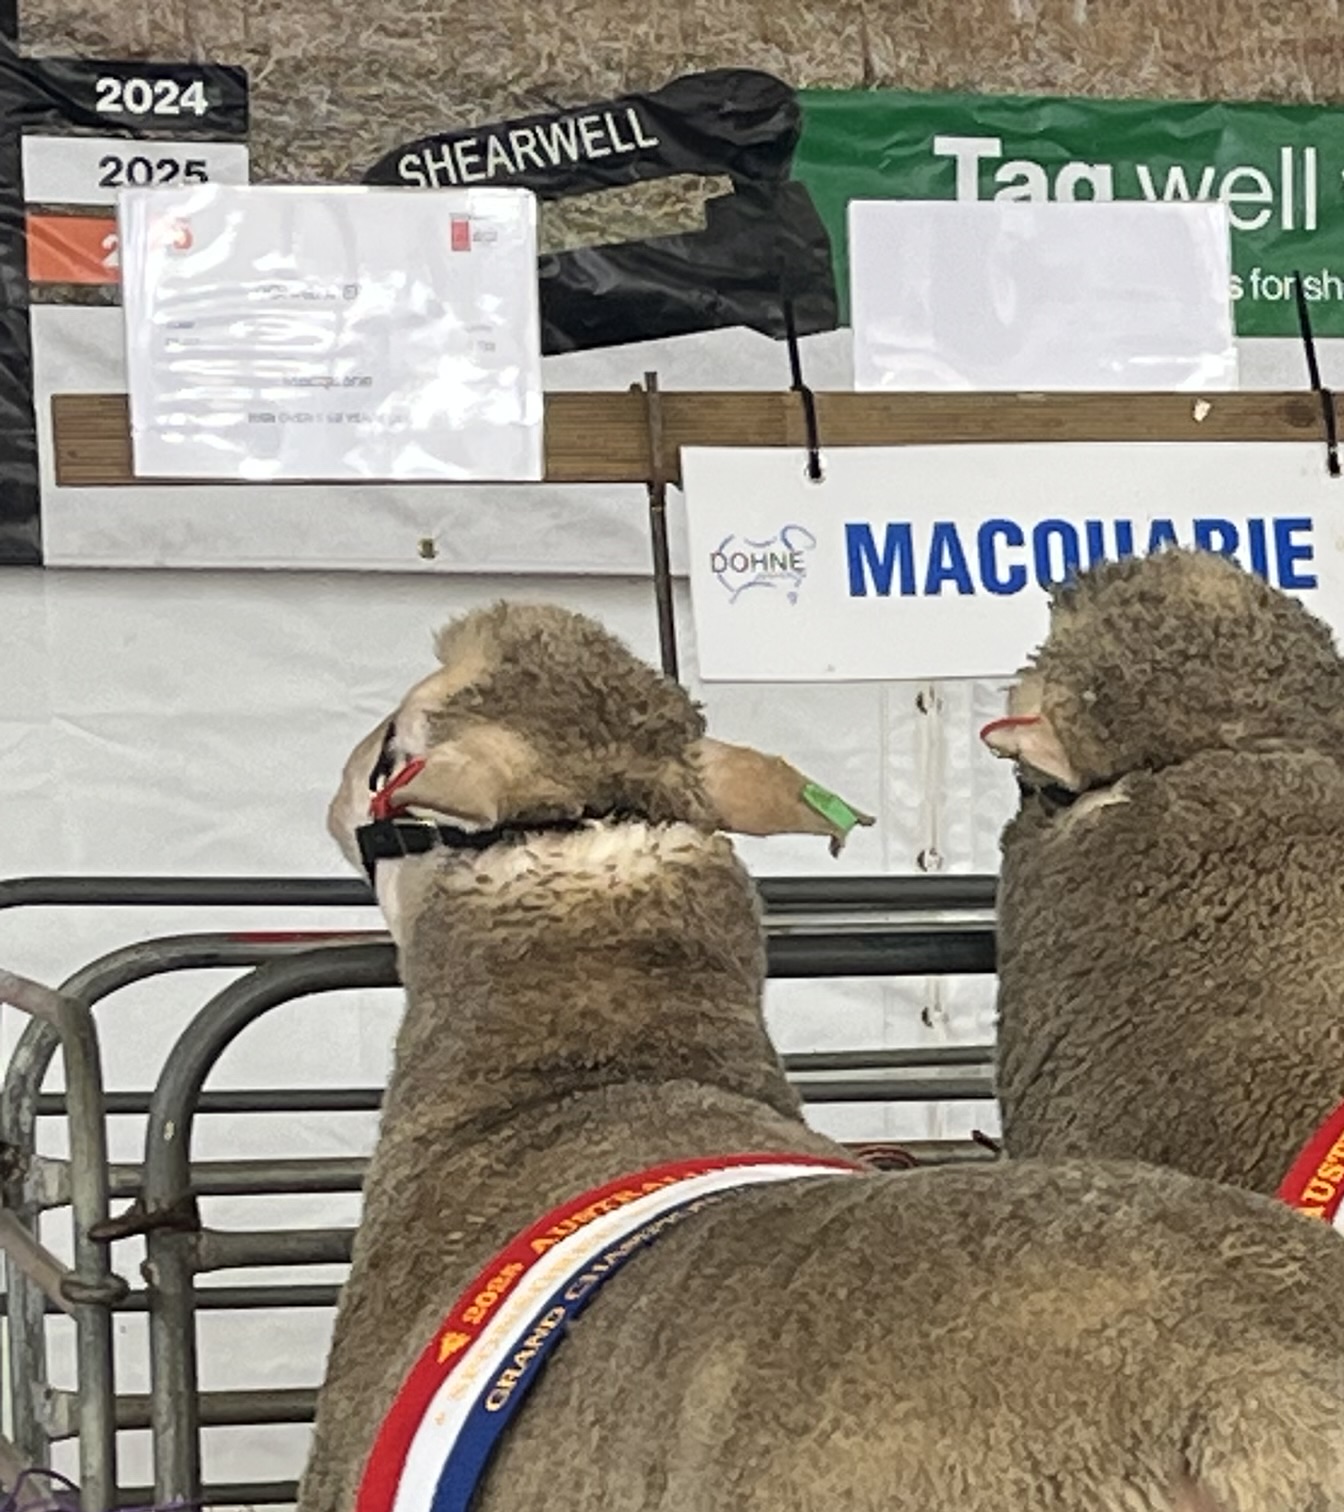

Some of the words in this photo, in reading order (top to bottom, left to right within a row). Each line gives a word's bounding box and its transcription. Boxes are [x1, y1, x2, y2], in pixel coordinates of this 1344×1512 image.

[95, 77, 208, 116] 2024
[399, 107, 659, 188] SHEARWELL
[99, 156, 208, 187] 2025
[1136, 146, 1317, 230] well
[1250, 268, 1297, 300] for
[709, 551, 804, 574] DOHNE
[485, 1305, 566, 1412] GRAND
